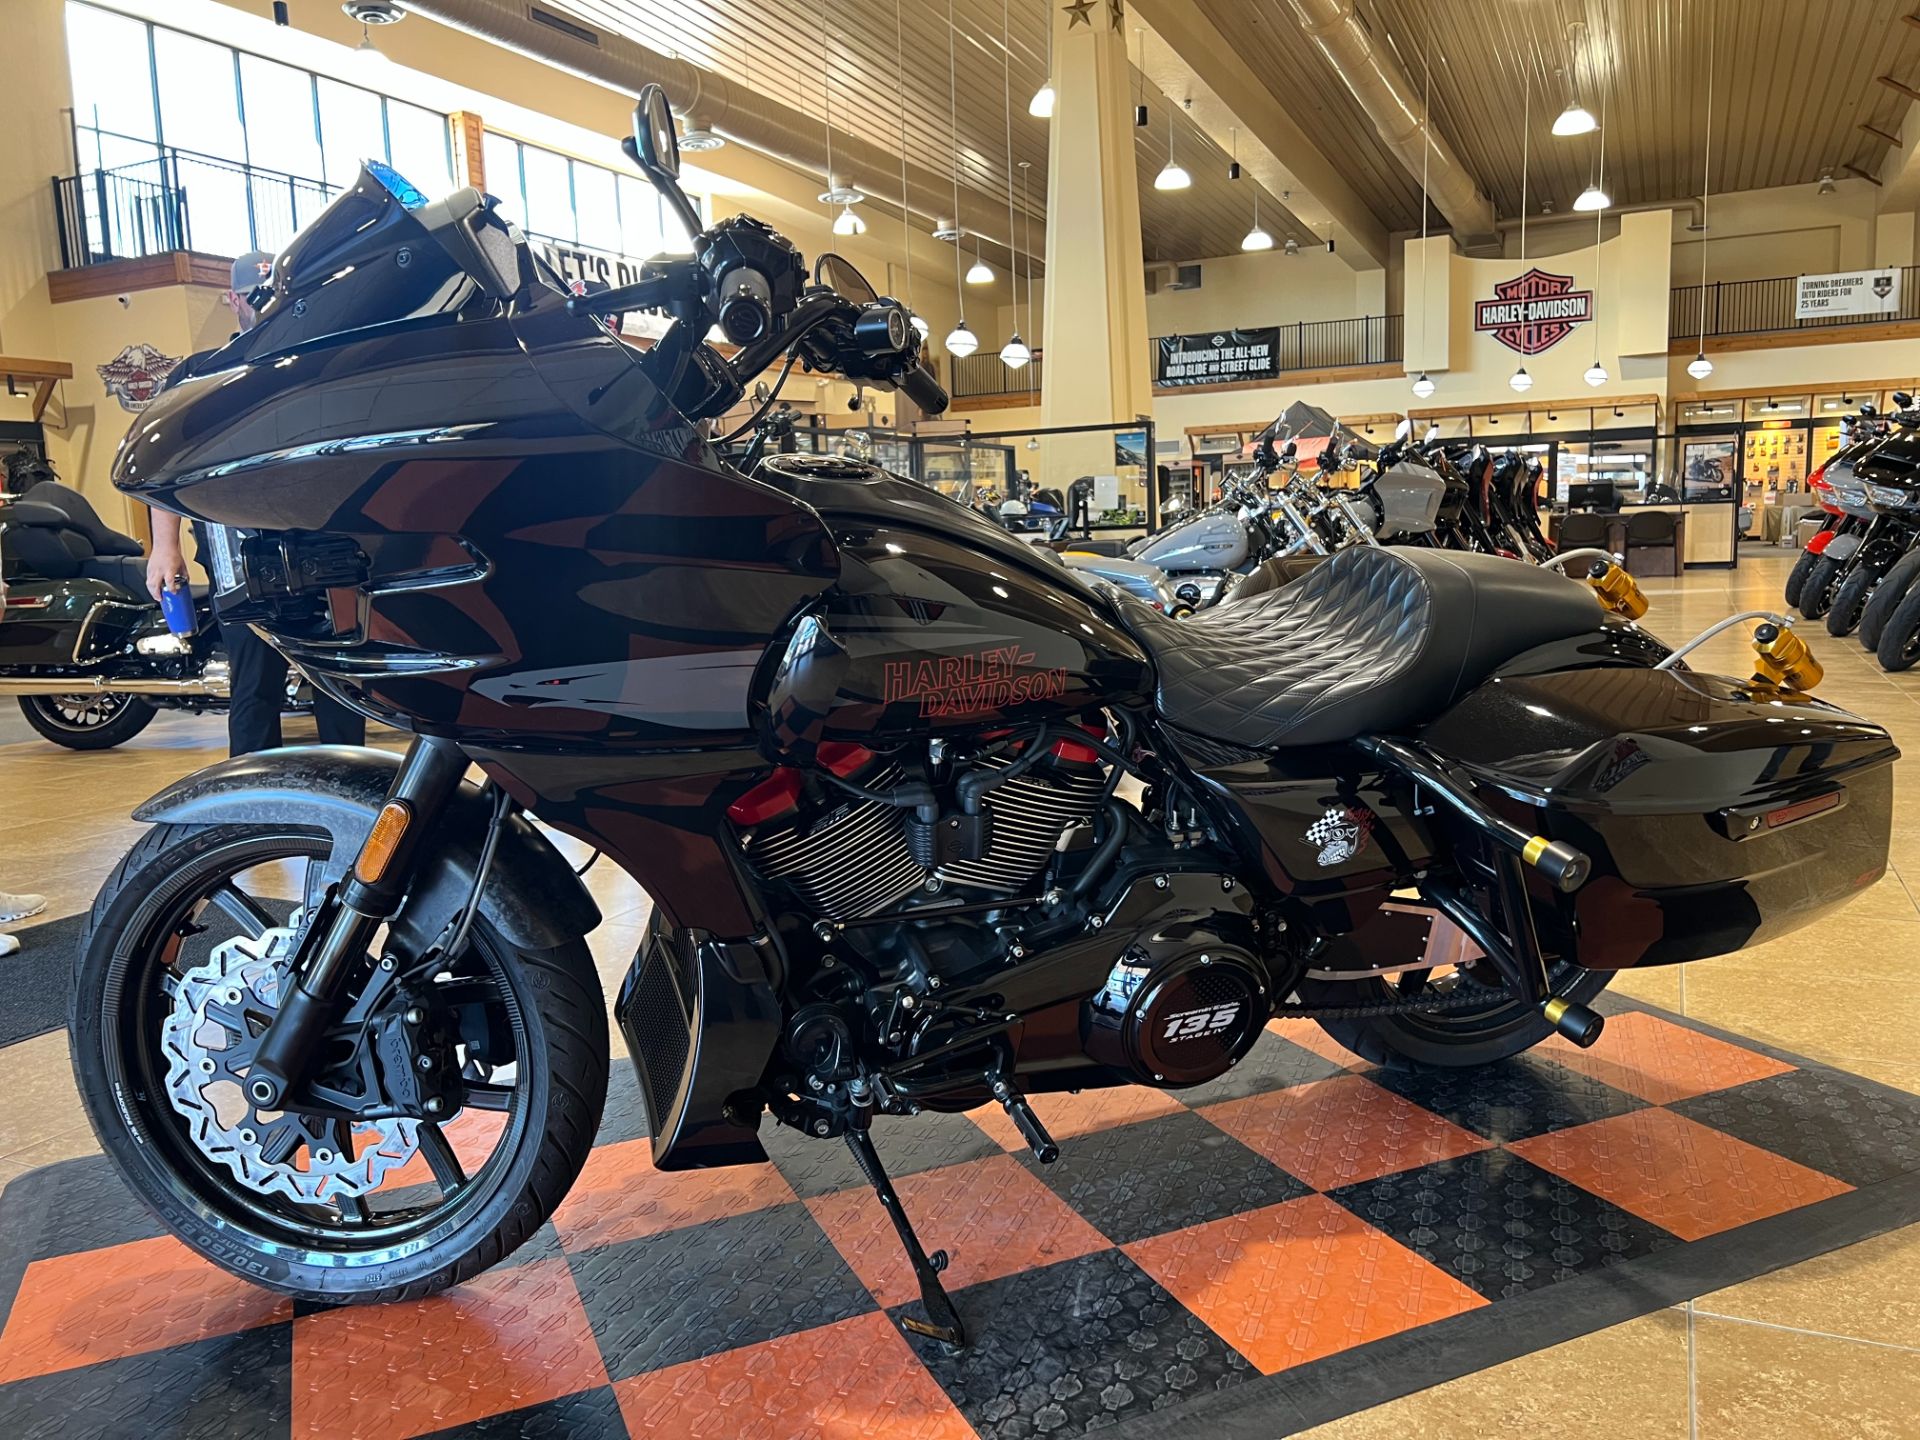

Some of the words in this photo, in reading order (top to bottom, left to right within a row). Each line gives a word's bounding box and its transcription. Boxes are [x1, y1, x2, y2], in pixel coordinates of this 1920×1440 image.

[1506, 277, 1562, 299] MOTOR
[1801, 290, 1816, 299] INTO
[1817, 288, 1839, 298] RIDERS
[1840, 287, 1852, 296] FOR
[1802, 280, 1830, 290] TURNING
[1831, 277, 1863, 287] DREAMERS
[1482, 297, 1586, 325] HARLEY-DAVIDSON
[1801, 299, 1810, 308] 25
[1810, 298, 1829, 308] YEARS
[1504, 323, 1560, 348] CYCLES
[1170, 349, 1220, 365] INTRODUCING
[1220, 347, 1235, 360] THE
[1235, 344, 1269, 358] ALL-NEW
[1166, 365, 1186, 377] ROAD
[1186, 363, 1207, 376] GLIDE
[1209, 363, 1220, 373] AND
[1220, 360, 1248, 373] STREET
[1248, 357, 1271, 371] GLIDE
[884, 645, 1036, 705] HARLEY-
[919, 667, 1066, 718] DAVIDSON
[1163, 1007, 1239, 1038] 135
[1169, 1030, 1212, 1043] STAGE
[390, 1037, 410, 1098] brembo
[198, 1234, 270, 1276] 130/60
